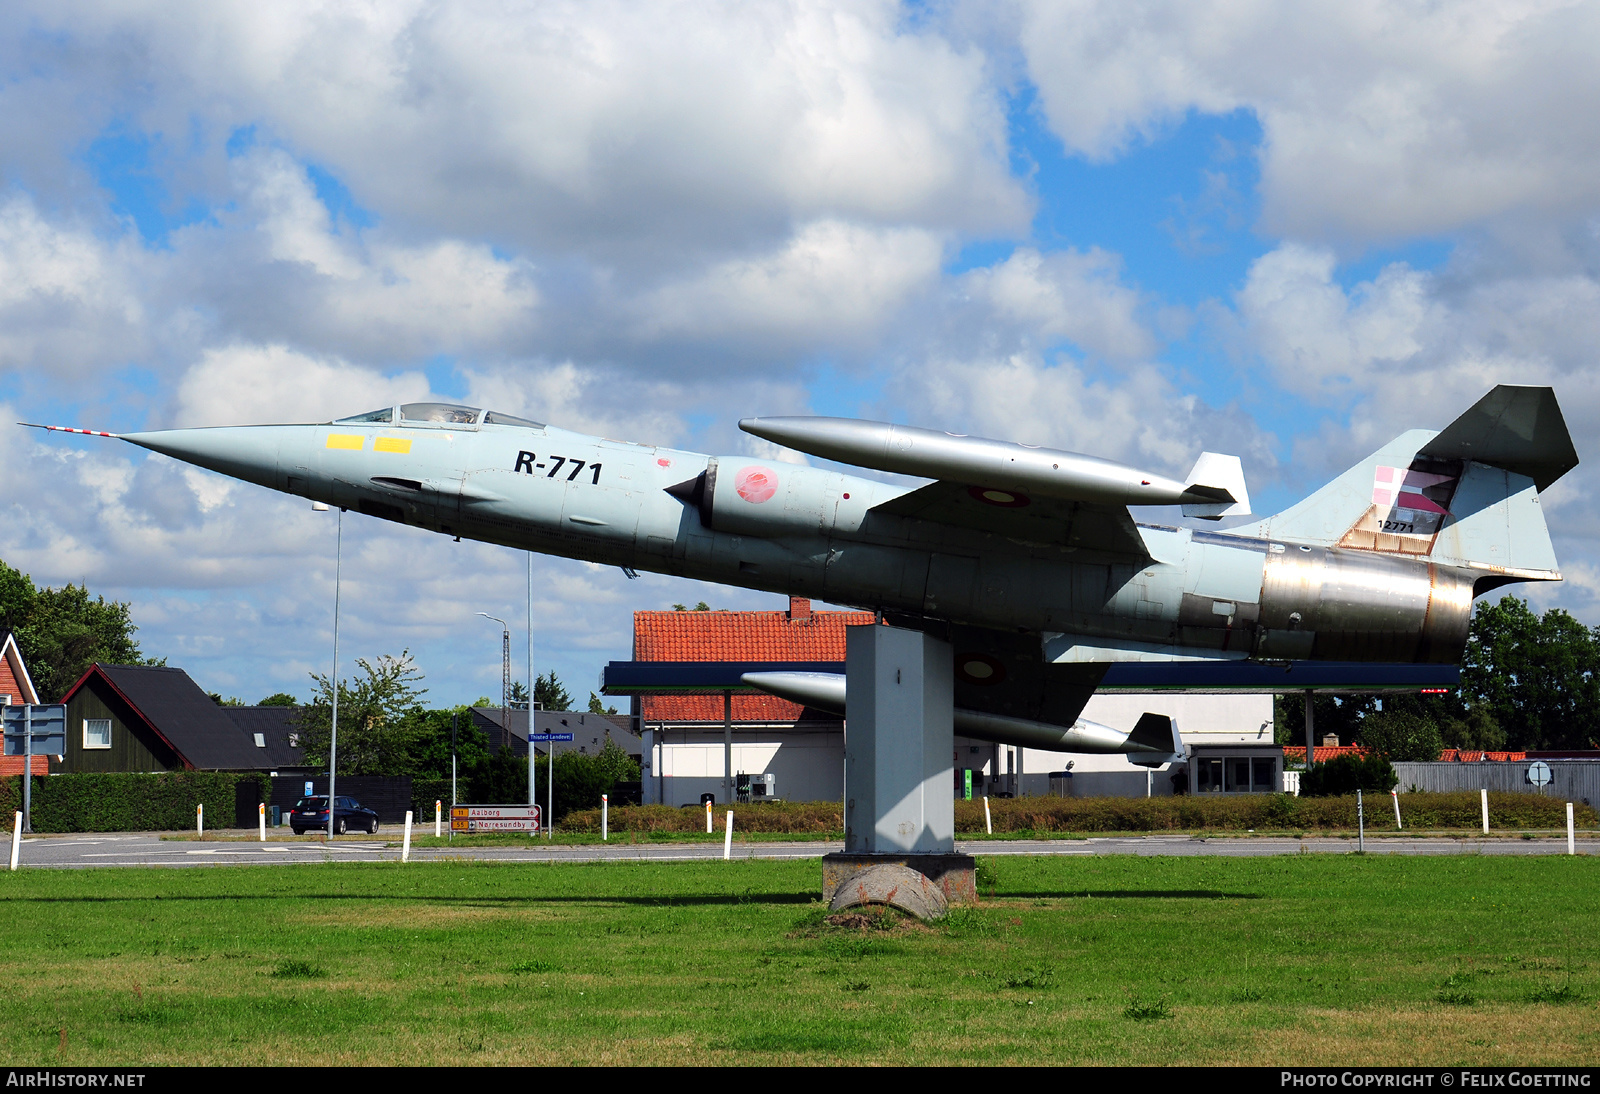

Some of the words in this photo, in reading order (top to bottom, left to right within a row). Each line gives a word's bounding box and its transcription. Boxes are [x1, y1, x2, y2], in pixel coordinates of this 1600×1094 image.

[514, 450, 602, 485] R-771
[1378, 520, 1414, 533] 12771
[471, 809, 500, 817] Aalborg
